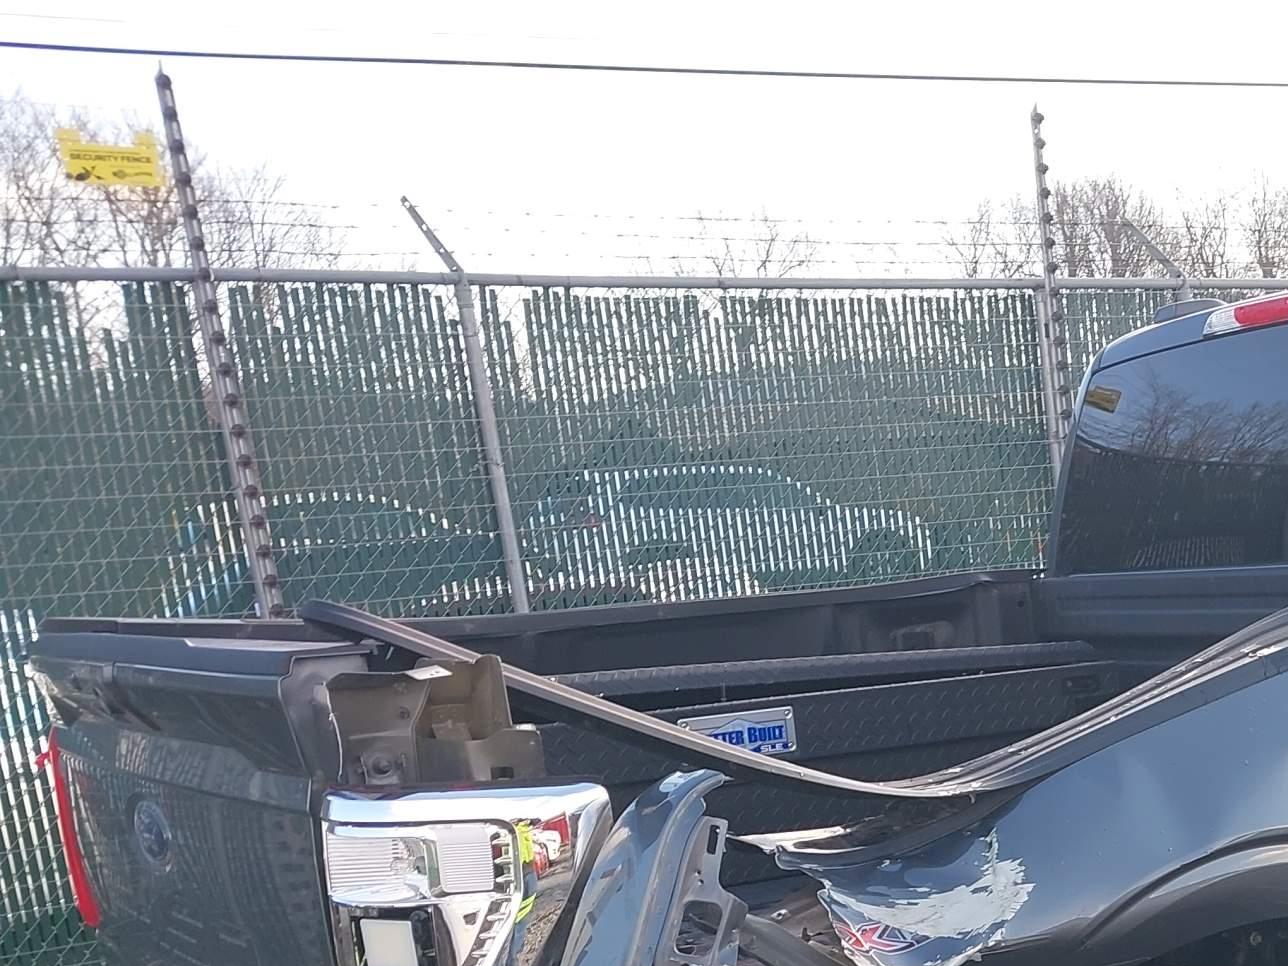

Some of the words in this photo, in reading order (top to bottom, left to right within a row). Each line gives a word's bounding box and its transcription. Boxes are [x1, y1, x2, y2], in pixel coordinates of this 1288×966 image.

[69, 152, 119, 162] SECURITY
[120, 154, 152, 164] FENCE
[747, 725, 784, 743] BUILT
